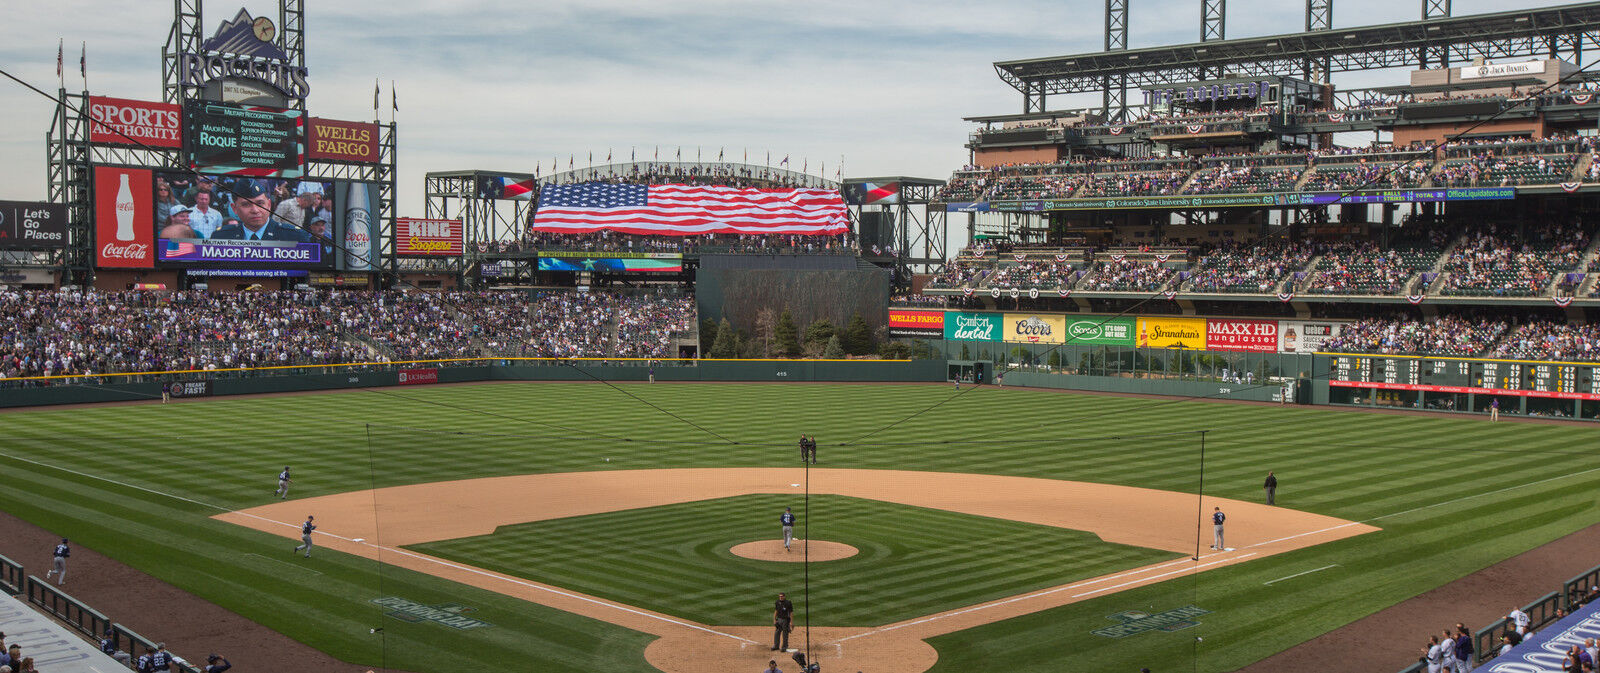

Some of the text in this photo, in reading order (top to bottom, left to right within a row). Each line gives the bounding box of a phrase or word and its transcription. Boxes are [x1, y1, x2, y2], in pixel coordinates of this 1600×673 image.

[180, 52, 310, 98] ROCKIES
[1142, 81, 1269, 105] THE ROOFTOP
[91, 103, 179, 129] SPORTS
[92, 121, 179, 140] AUTHORITY
[202, 124, 235, 134] MAJOR PAUL
[315, 125, 370, 142] WELLS
[200, 132, 237, 148] ROQUE
[316, 140, 369, 156] FARGO
[1447, 190, 1514, 199] OfficeLiquidators.com
[1144, 199, 1158, 207] State
[1158, 198, 1190, 207] University
[24, 208, 50, 219] Let's
[24, 218, 40, 229] Go
[408, 221, 451, 238] KING
[24, 230, 62, 240] Places
[344, 229, 370, 242] Coors
[102, 242, 148, 259] Coca-Cola
[408, 236, 452, 254] Soopers
[202, 247, 310, 260] MAJOR PAUL ROQUE
[890, 314, 944, 324] WELLS FARGO
[956, 314, 989, 326] Comfort
[954, 324, 994, 340] dental
[1016, 320, 1052, 335] Coors
[1150, 325, 1200, 340] Stranahan's
[1208, 322, 1276, 336] MAXX HD
[1305, 324, 1325, 335] weber
[1208, 335, 1275, 344] sunglasses
